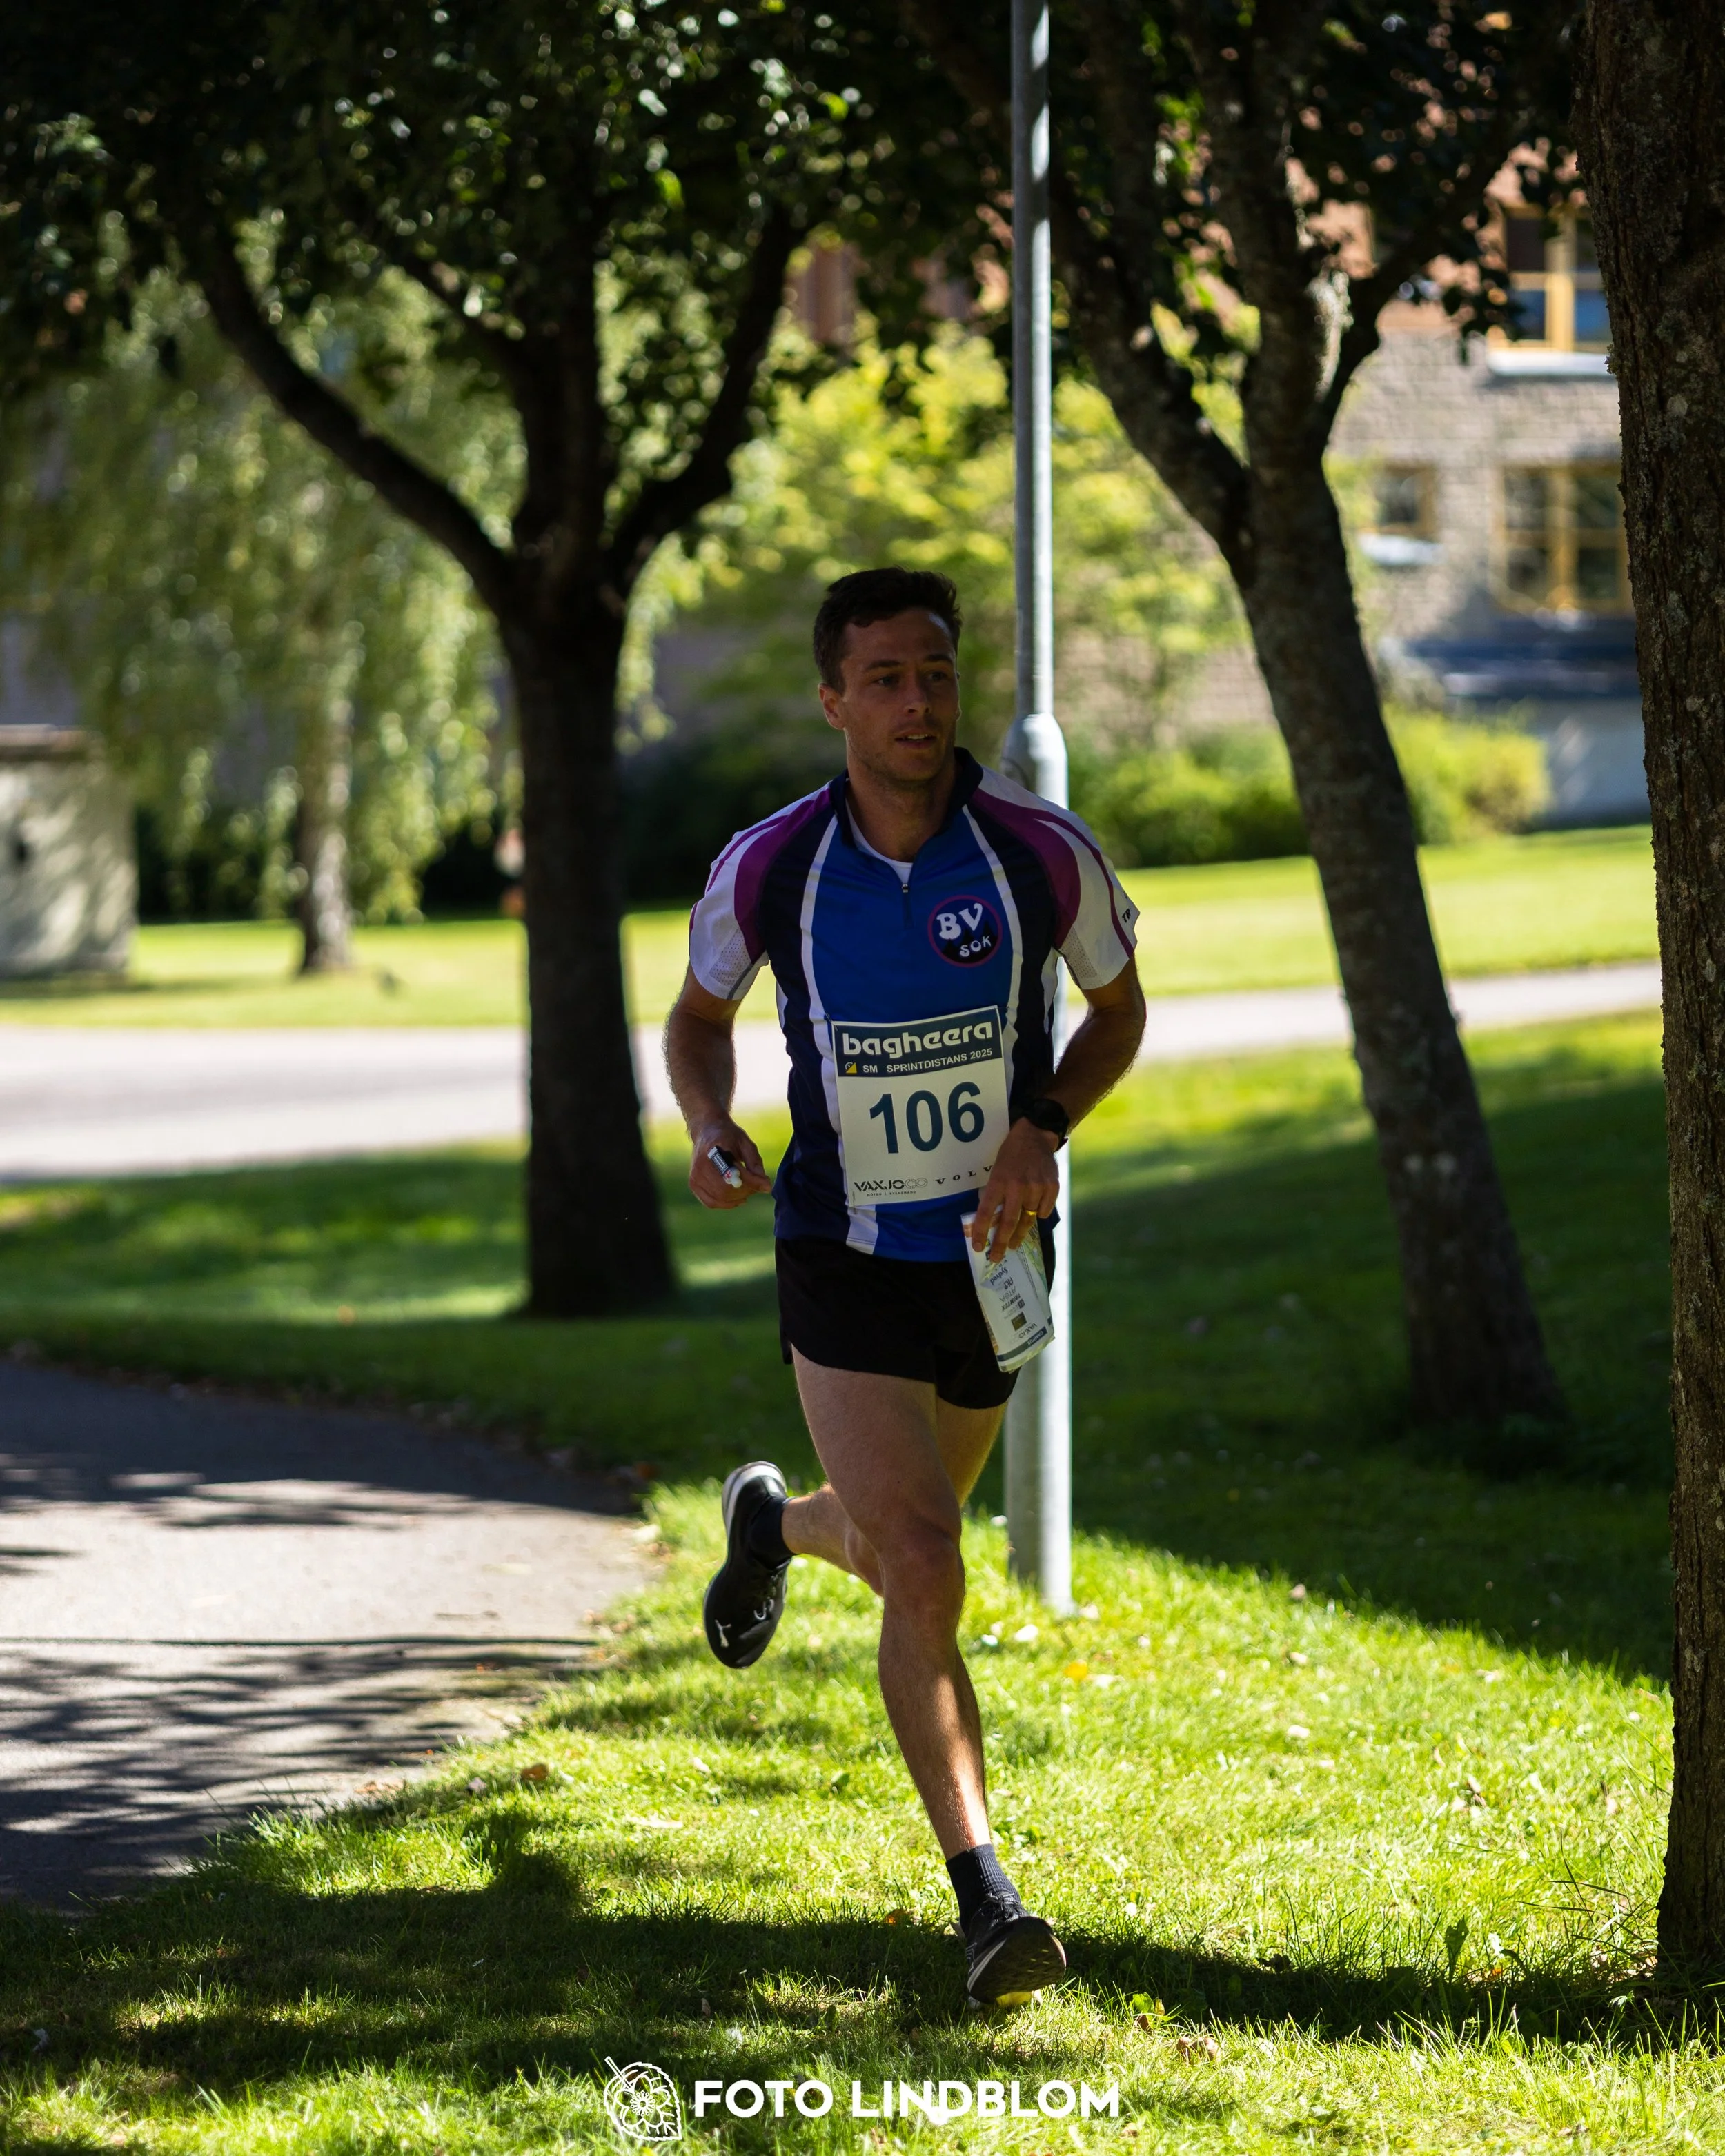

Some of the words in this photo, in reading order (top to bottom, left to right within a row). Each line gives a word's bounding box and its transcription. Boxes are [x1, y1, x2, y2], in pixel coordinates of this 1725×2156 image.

[936, 902, 983, 940] BV
[959, 935, 992, 958] SOK
[842, 1021, 993, 1059] bagheera
[862, 1065, 878, 1074] SM
[887, 1053, 967, 1074] SPRINTDISTANS
[970, 1047, 993, 1060] 2025
[869, 1081, 985, 1154] 106
[989, 1266, 1009, 1286] Sydved
[1027, 1329, 1045, 1345] CAMPUS
